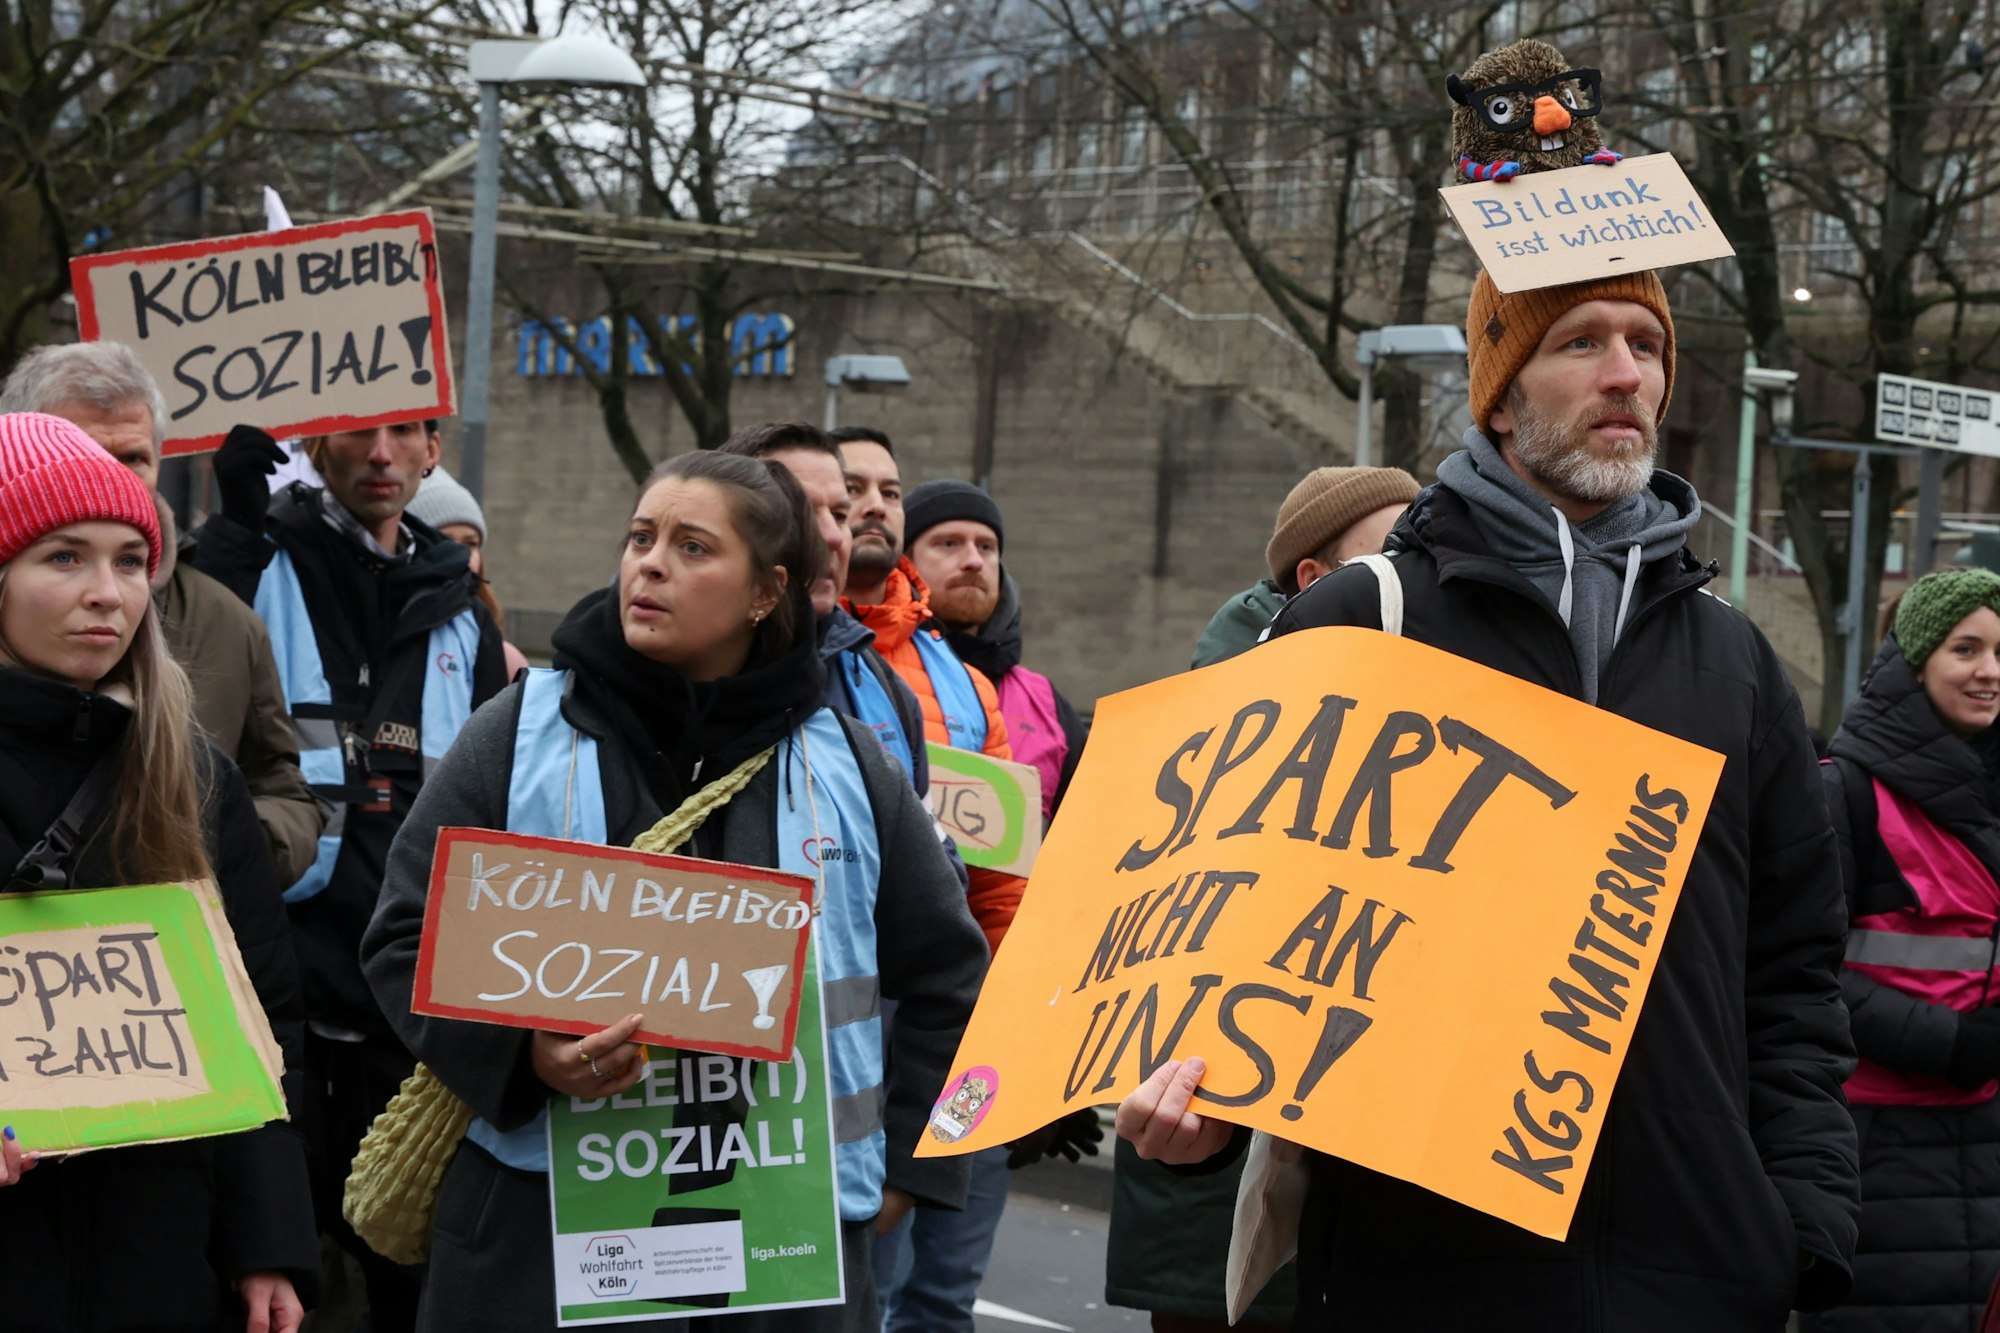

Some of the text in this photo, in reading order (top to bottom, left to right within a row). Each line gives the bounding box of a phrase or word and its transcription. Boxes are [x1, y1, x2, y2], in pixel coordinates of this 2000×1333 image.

[1472, 177, 1662, 230] Bildunk
[1496, 200, 1707, 259] isst wichtich!
[130, 252, 285, 340] KÖLN
[171, 315, 433, 421] SOZIAL!
[1114, 695, 1579, 874] SPART
[467, 853, 616, 912] KÖLN
[1072, 870, 1416, 1002] NICHT AN
[477, 930, 788, 1030] SOZIAL!
[1491, 773, 1690, 1195] KGS MATERNUS
[15, 1008, 188, 1077] ZAHLT
[1064, 974, 1373, 1121] UNS!
[577, 1118, 807, 1181] SOZIAL!
[580, 1260, 643, 1274] Wohlfahrt
[597, 1244, 624, 1258] Liga
[599, 1276, 627, 1289] Köln
[751, 1243, 817, 1261] liga.koeln
